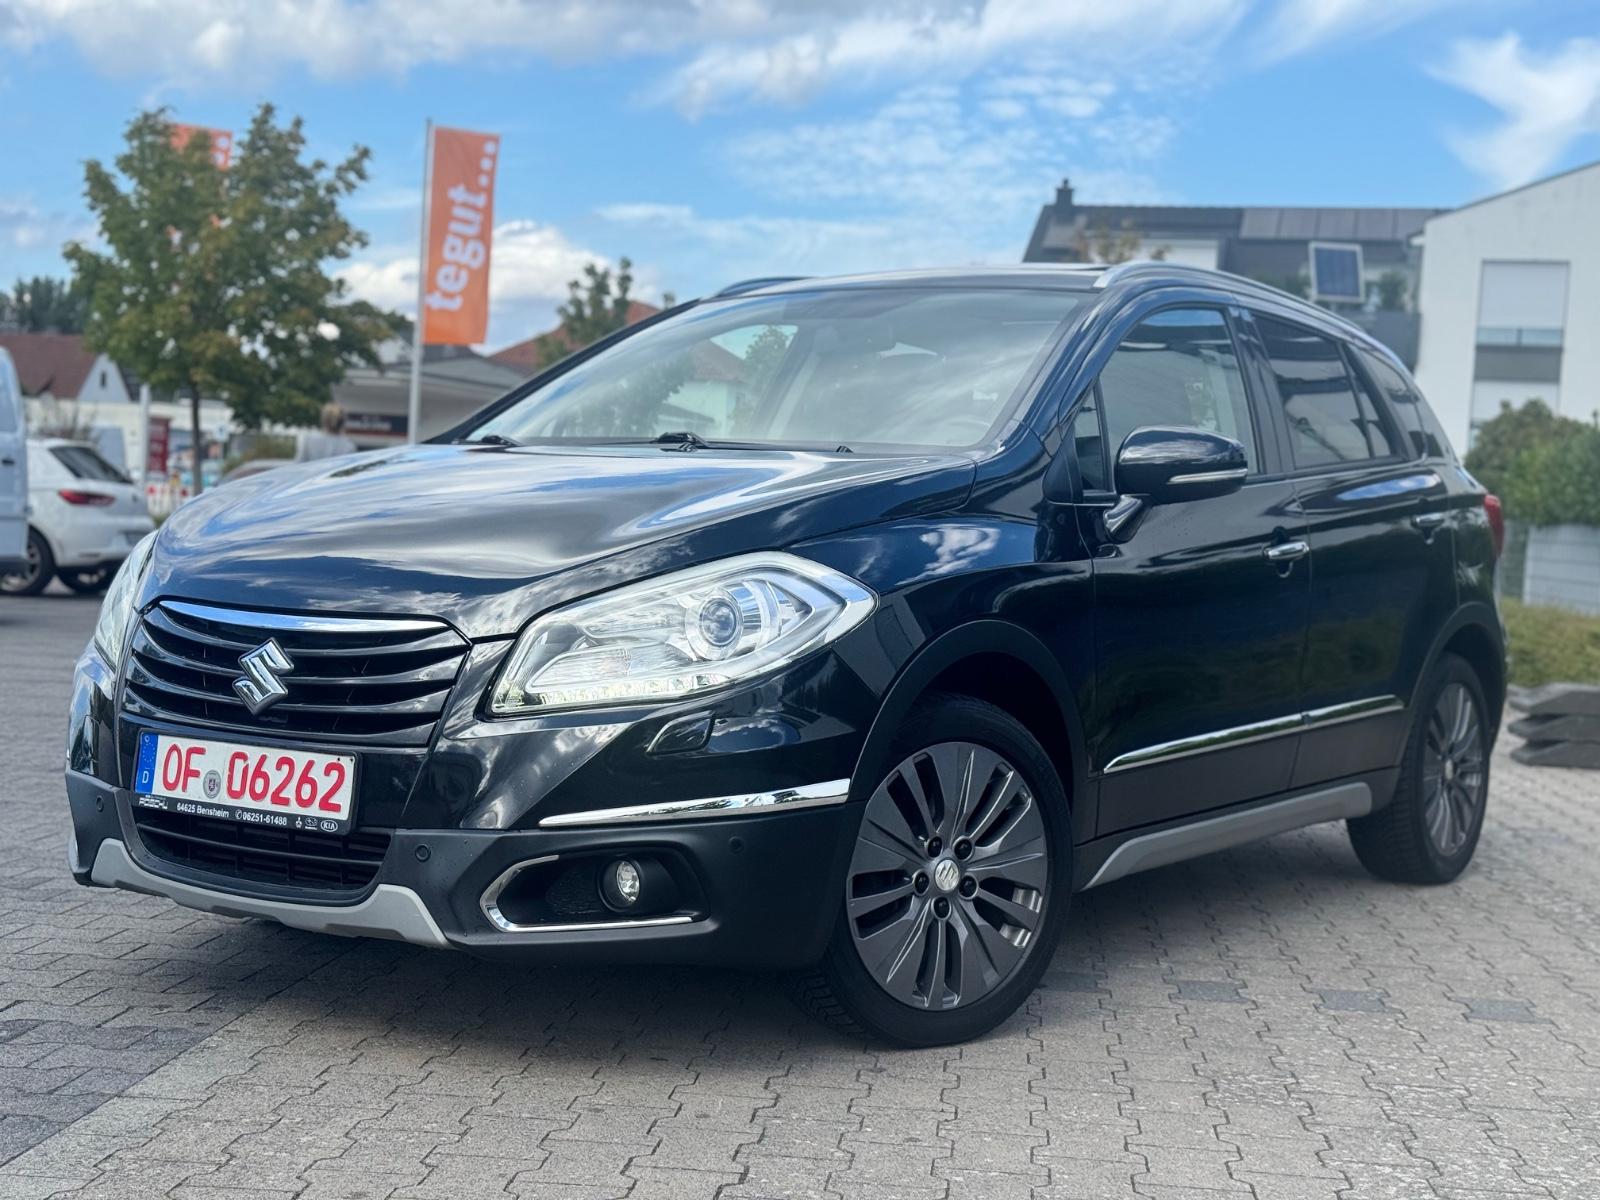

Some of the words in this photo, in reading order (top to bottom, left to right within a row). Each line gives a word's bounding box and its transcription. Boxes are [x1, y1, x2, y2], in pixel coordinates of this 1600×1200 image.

[424, 141, 497, 311] tegut...
[142, 771, 150, 784] D
[162, 743, 206, 793] OF
[226, 751, 346, 813] 06262
[177, 802, 195, 813] 64625
[197, 805, 229, 818] Bensheim
